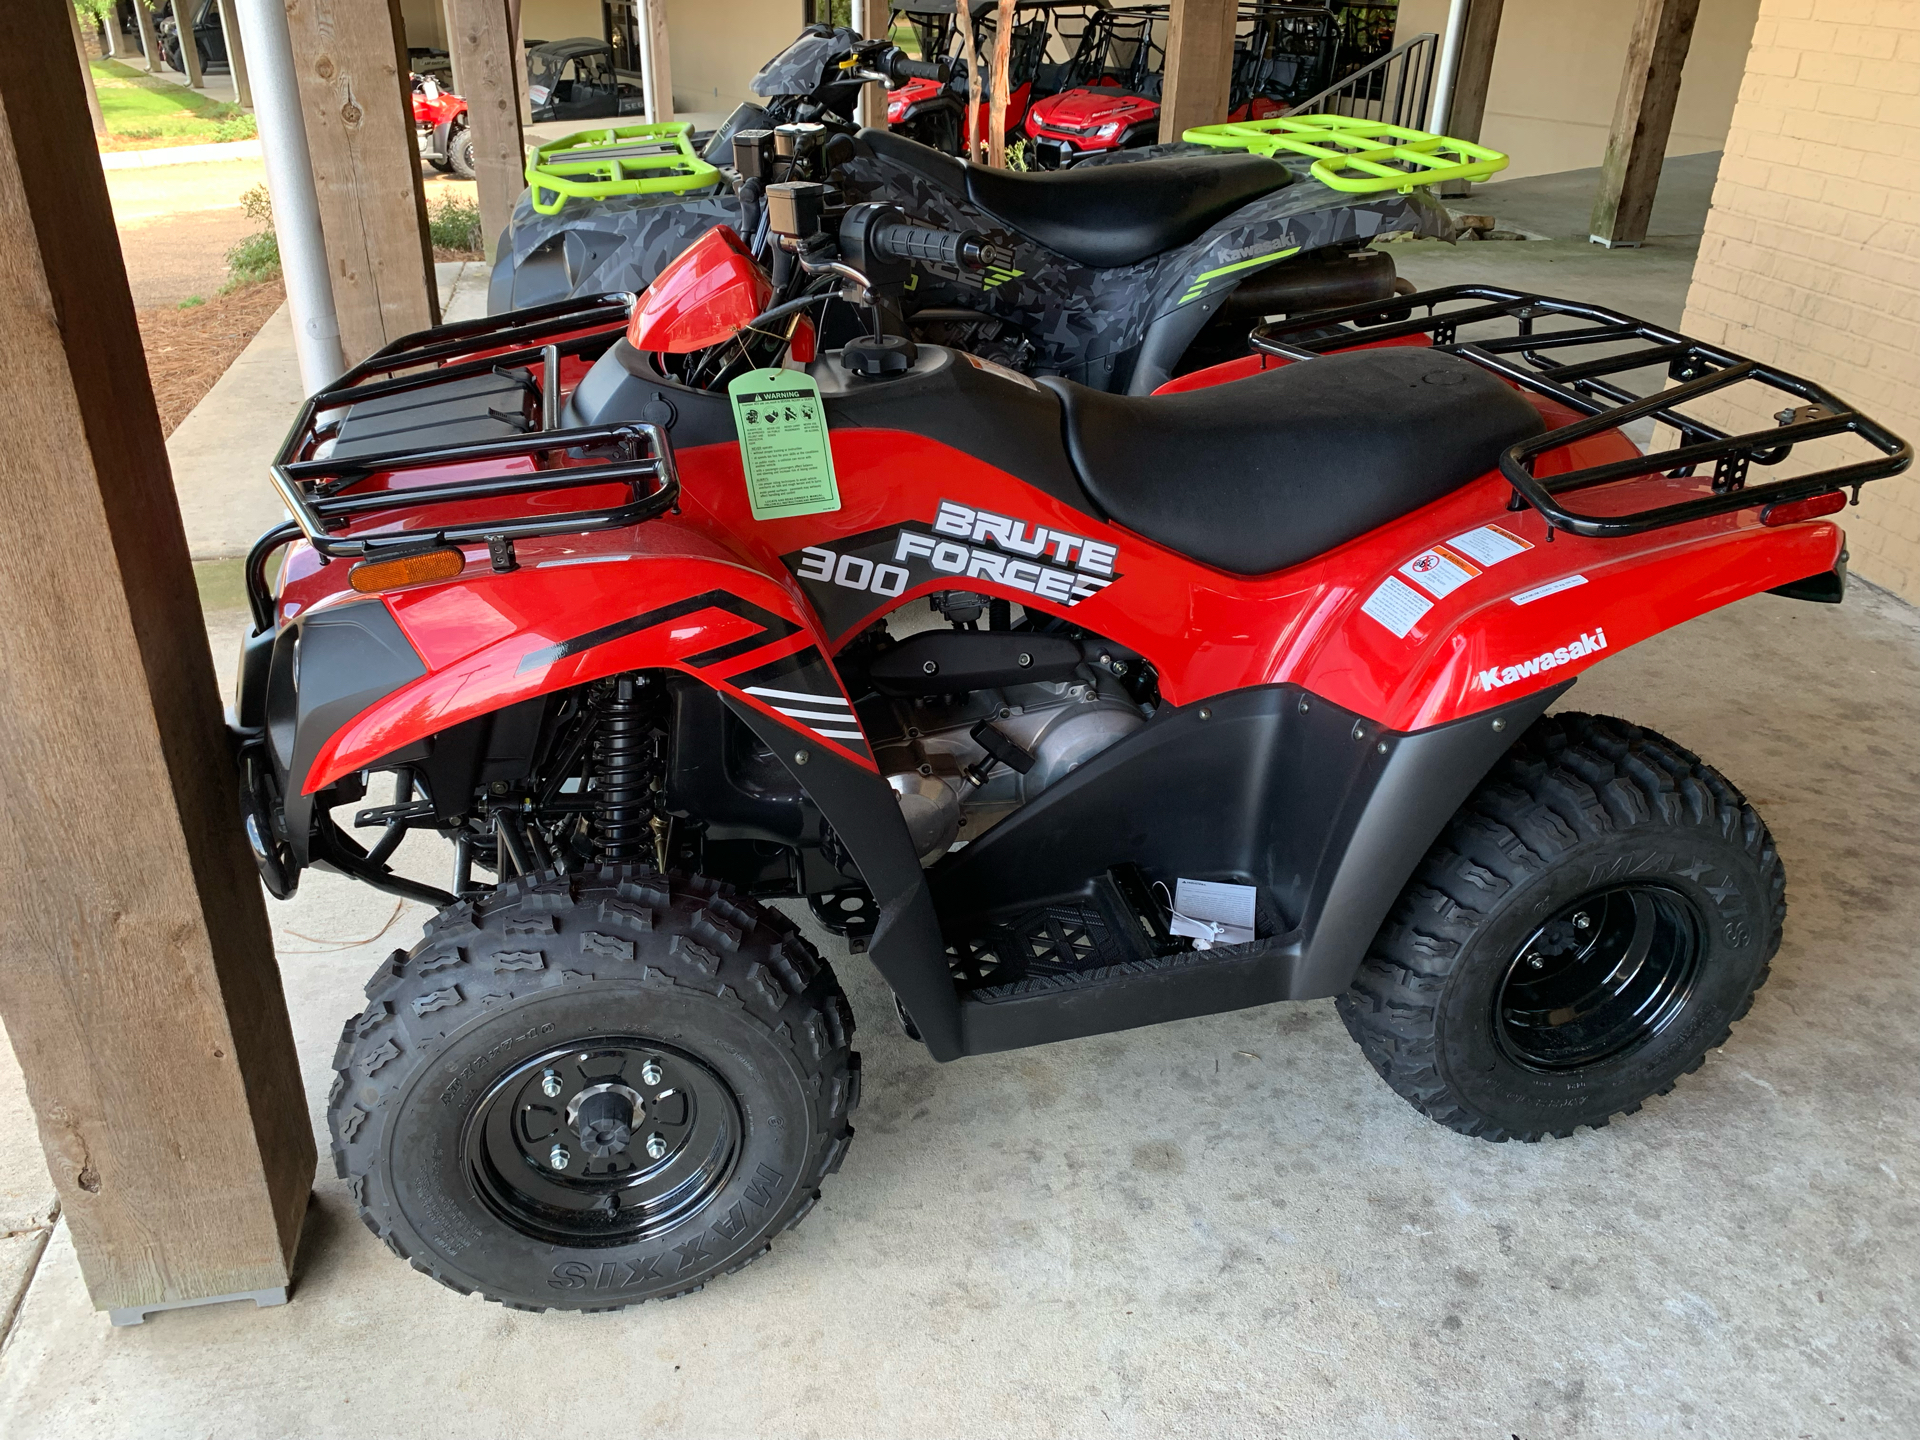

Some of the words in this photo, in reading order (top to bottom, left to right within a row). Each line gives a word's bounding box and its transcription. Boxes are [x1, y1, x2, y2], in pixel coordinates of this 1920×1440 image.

[1217, 231, 1297, 264] Kawasaki
[763, 391, 800, 400] WARNING
[894, 531, 1076, 604] FORCE
[934, 500, 1118, 575] BRUTE
[796, 545, 911, 599] 300
[1478, 627, 1608, 691] Kawasaki
[1586, 851, 1752, 949] MAXXIS
[545, 1161, 785, 1290] MAXXIS
